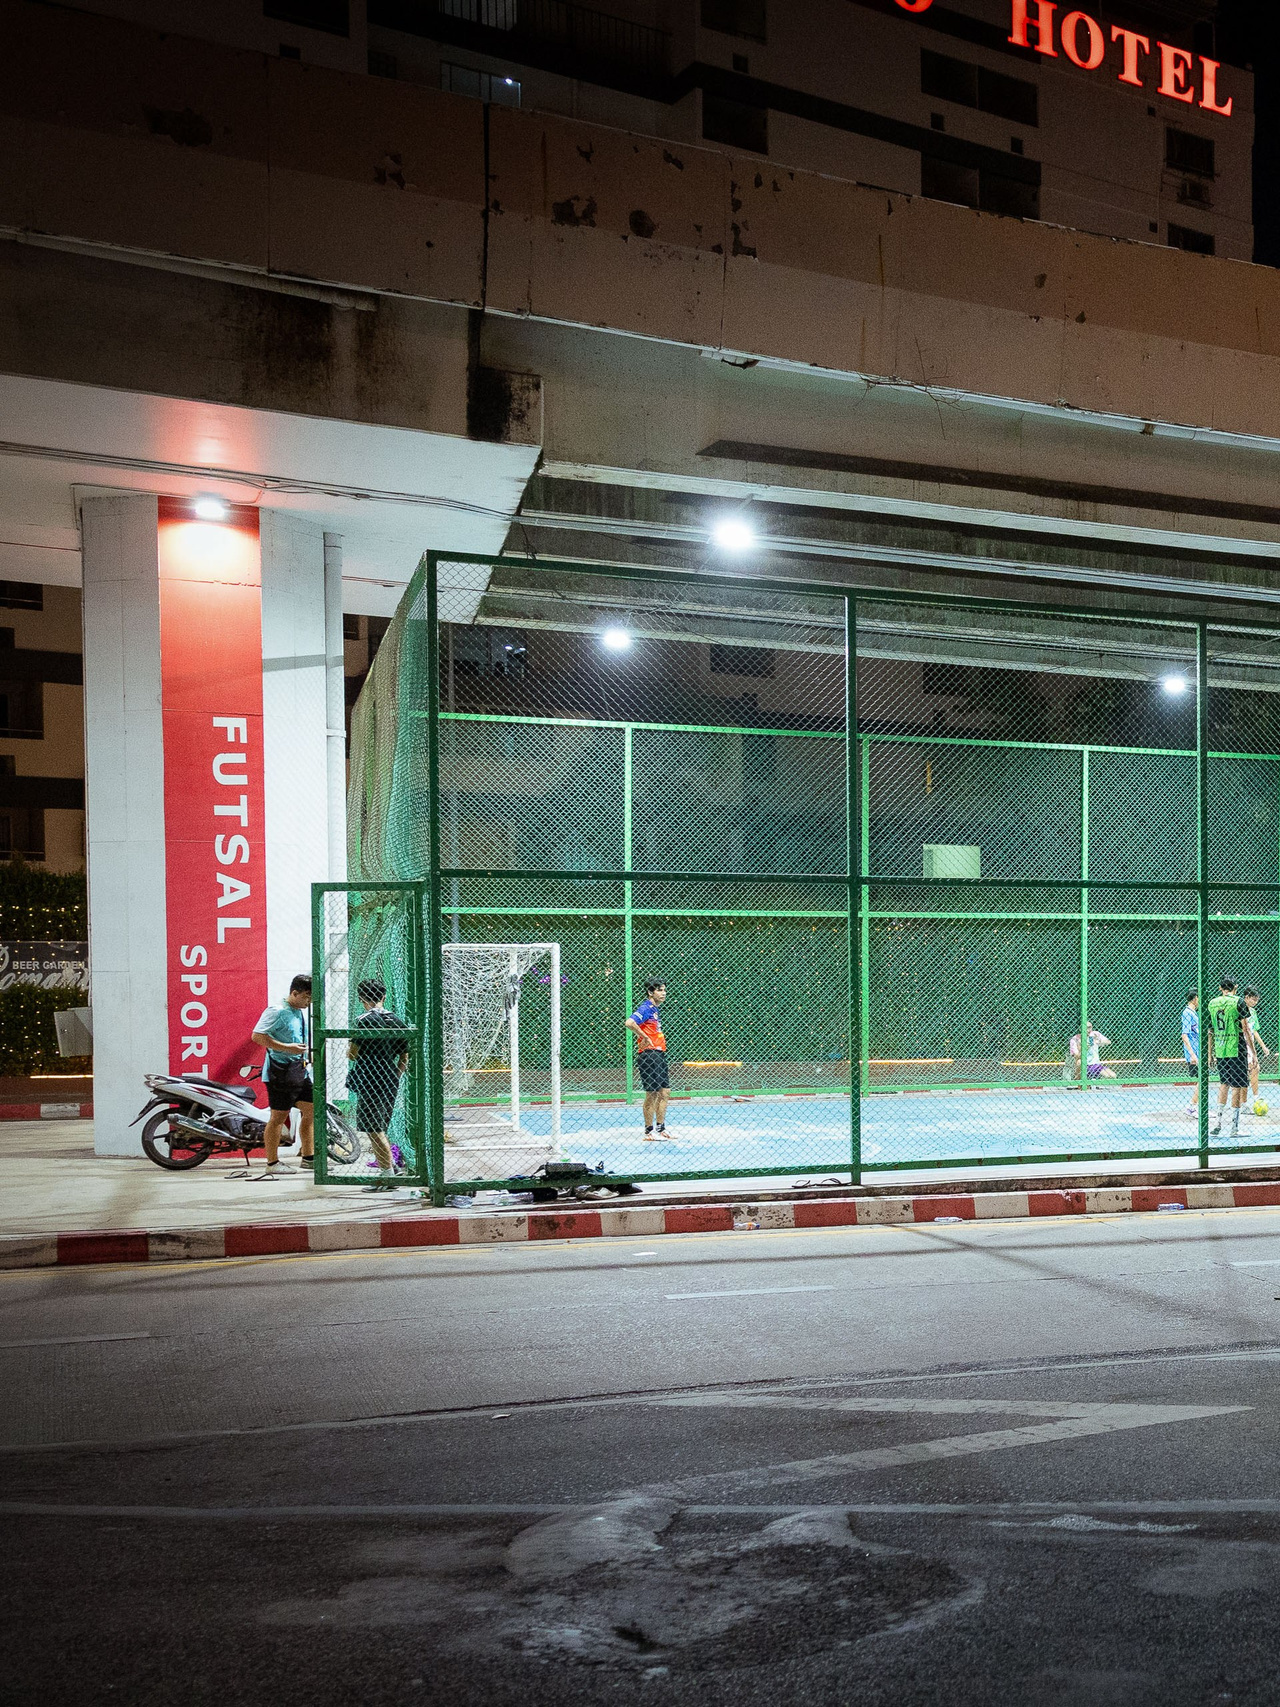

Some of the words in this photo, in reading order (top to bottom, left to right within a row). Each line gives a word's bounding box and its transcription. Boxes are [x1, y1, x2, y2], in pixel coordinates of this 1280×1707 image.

[1007, 0, 1233, 116] HOTEL
[212, 716, 252, 944] FUTSAL
[12, 960, 40, 970] BEER
[42, 960, 85, 970] GARDEN
[179, 945, 209, 1080] SPORT
[1216, 1009, 1225, 1031] 6
